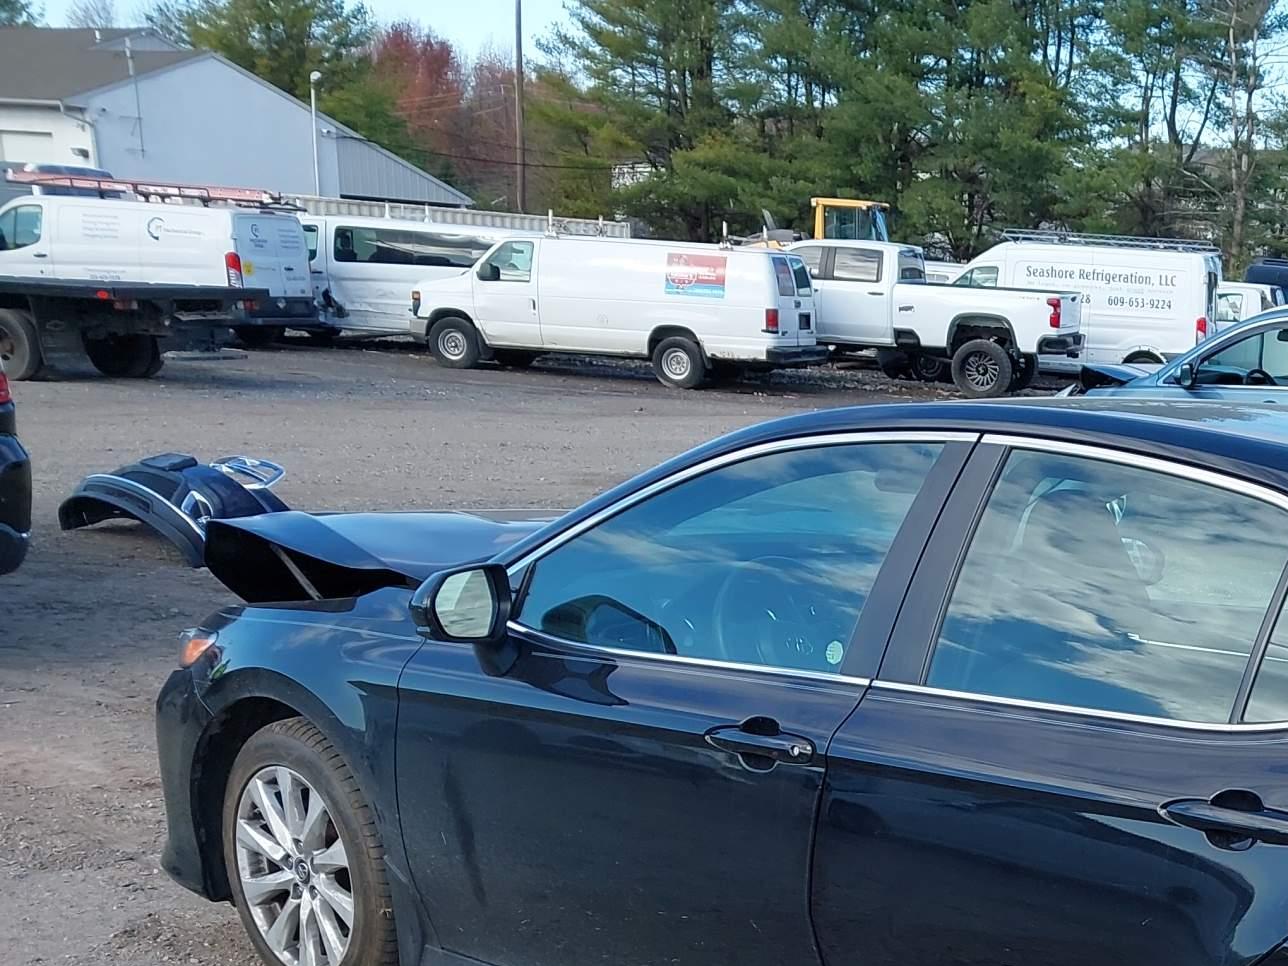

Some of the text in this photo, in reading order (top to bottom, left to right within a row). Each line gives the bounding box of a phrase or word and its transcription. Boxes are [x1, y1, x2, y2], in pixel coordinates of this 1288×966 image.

[1026, 265, 1177, 287] Seashore Refrigeration, LLC
[1107, 296, 1172, 310] 609-653-9224
